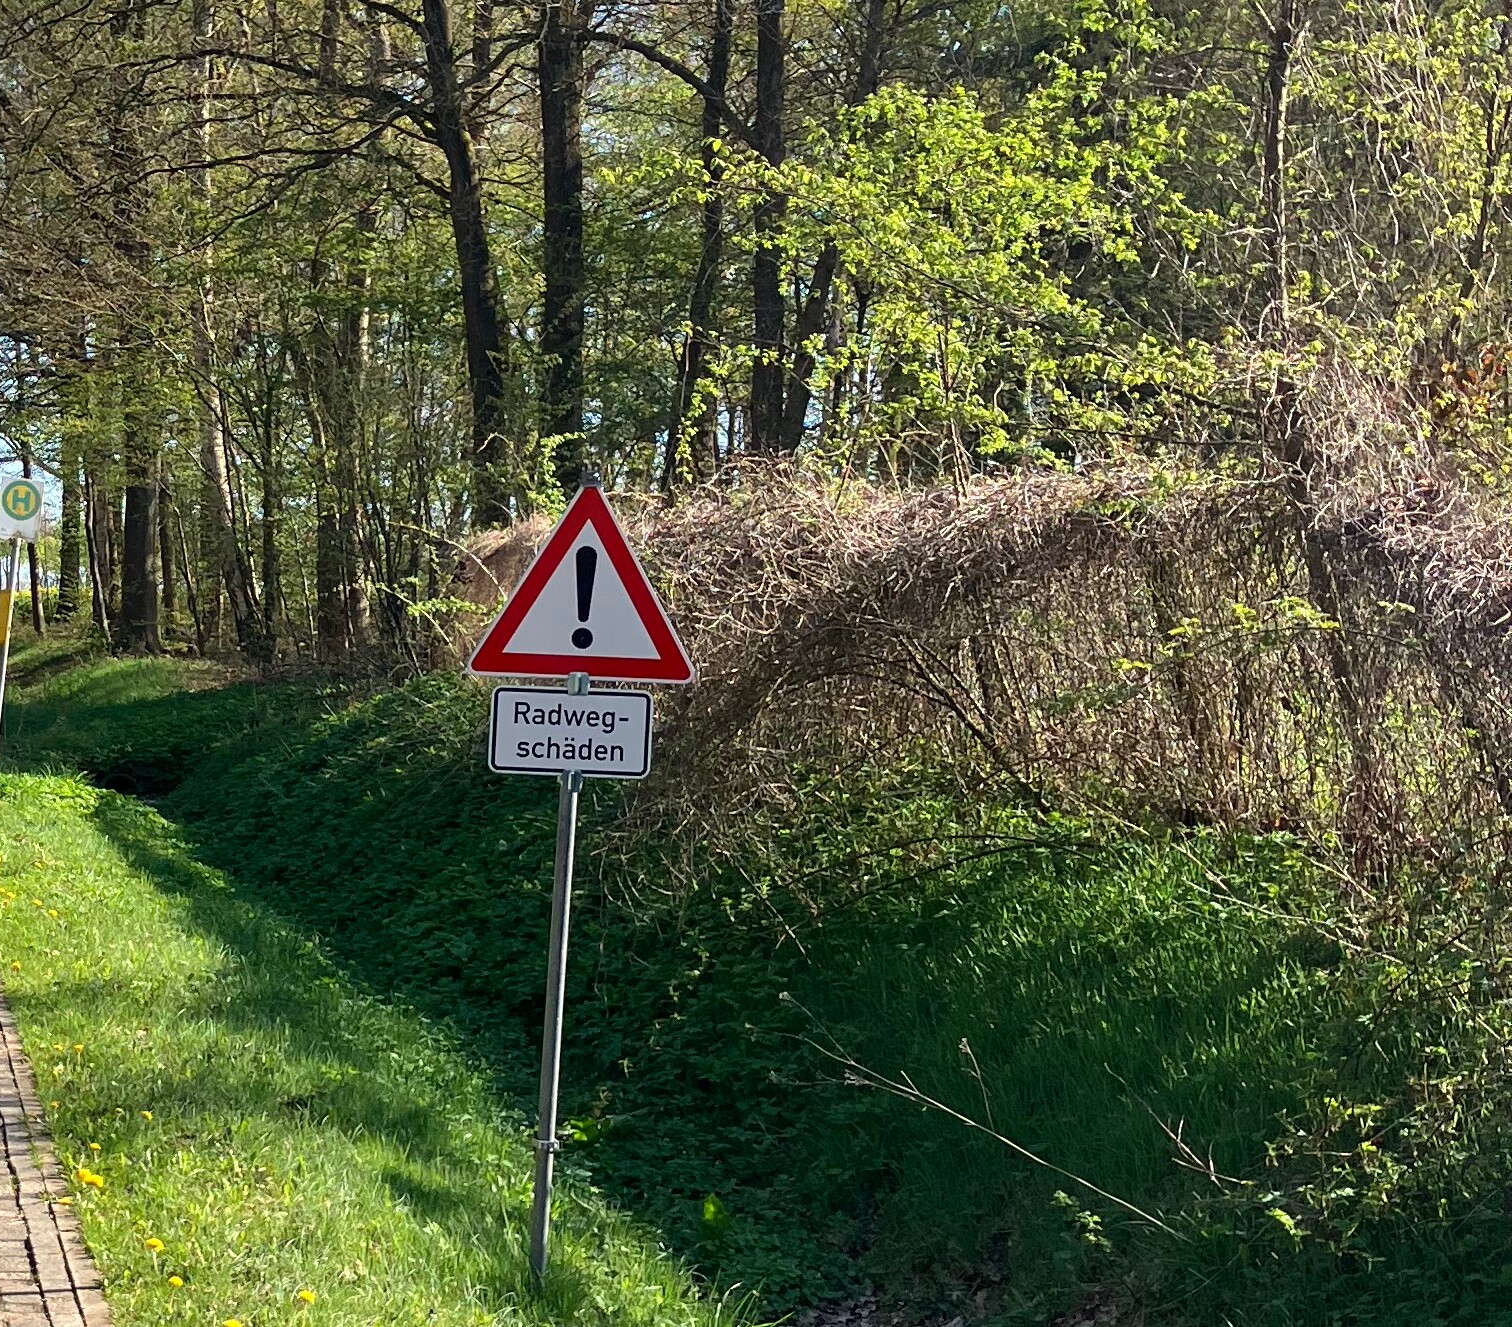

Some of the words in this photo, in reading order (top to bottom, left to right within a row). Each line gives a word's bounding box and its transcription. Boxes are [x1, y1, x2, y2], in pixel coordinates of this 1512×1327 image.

[12, 489, 32, 512] H
[513, 701, 629, 734] Radweg-
[516, 736, 624, 762] schäden
